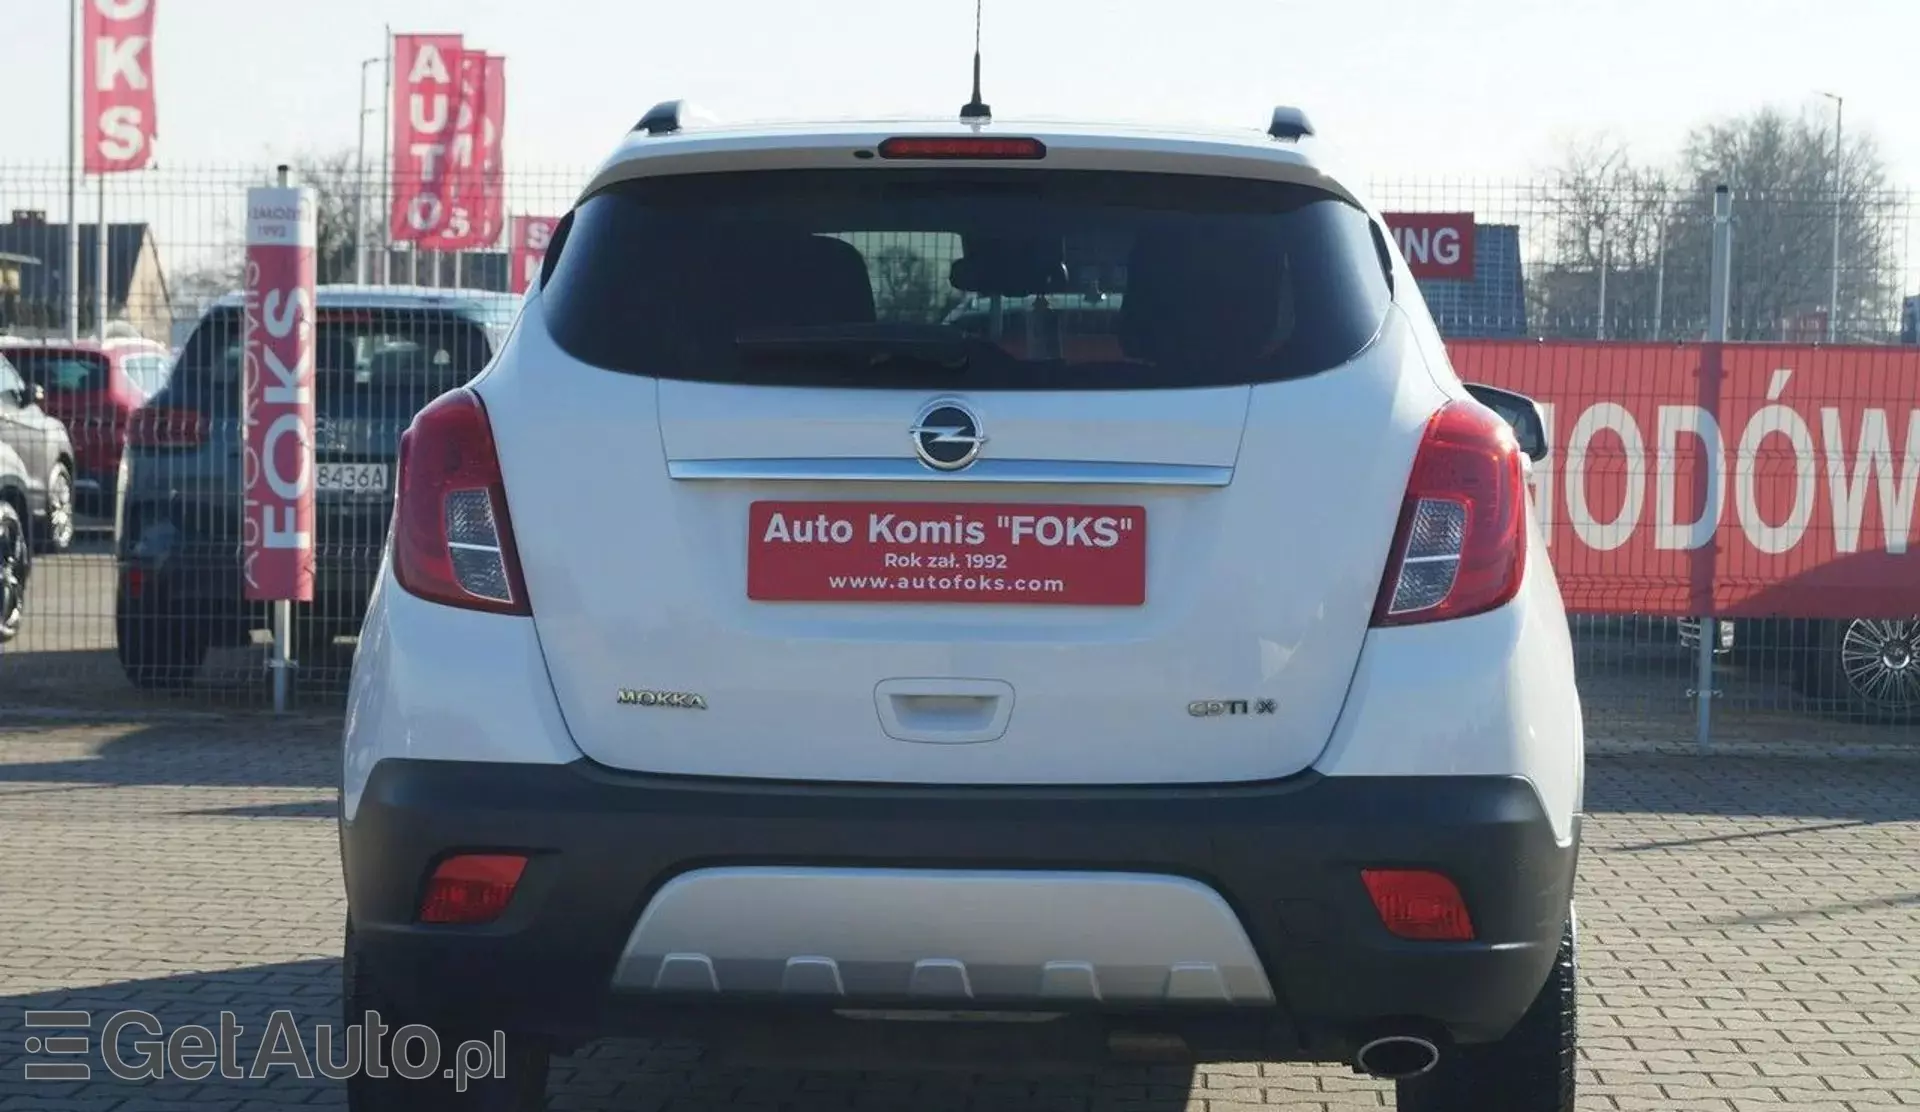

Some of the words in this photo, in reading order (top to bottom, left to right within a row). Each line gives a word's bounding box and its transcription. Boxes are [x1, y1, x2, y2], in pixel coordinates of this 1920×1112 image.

[406, 43, 451, 232] AUTO
[262, 287, 311, 548] FOKS
[763, 512, 853, 544] Auto
[868, 513, 985, 545] Komis
[997, 515, 1133, 548] "FOKS"
[885, 552, 922, 568] Rok
[928, 553, 960, 569] zał.
[965, 554, 1008, 569] 1992
[829, 574, 1065, 592] www.autofoks.com
[617, 688, 708, 710] MOKKA
